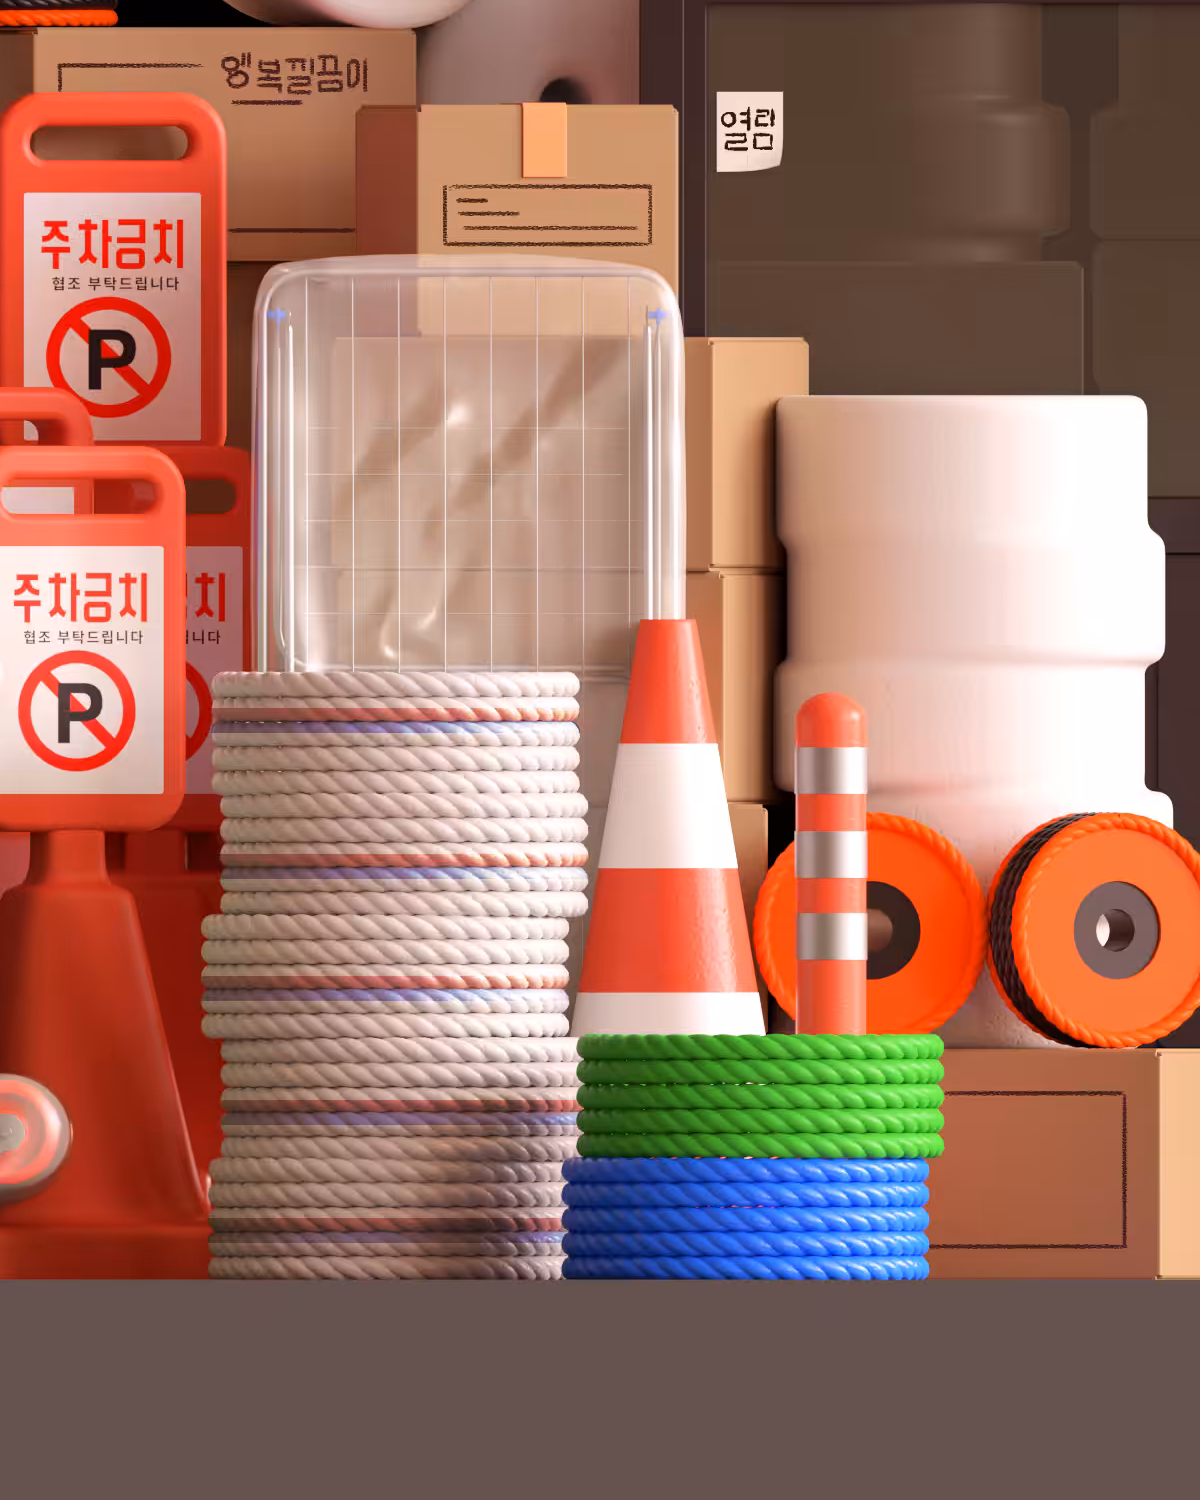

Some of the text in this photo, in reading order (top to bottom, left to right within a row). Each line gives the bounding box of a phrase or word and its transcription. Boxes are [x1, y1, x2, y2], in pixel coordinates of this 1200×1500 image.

[52, 276, 179, 291] 협조 부탁드립니다
[24, 630, 143, 645] 협조 부탁드립니다
